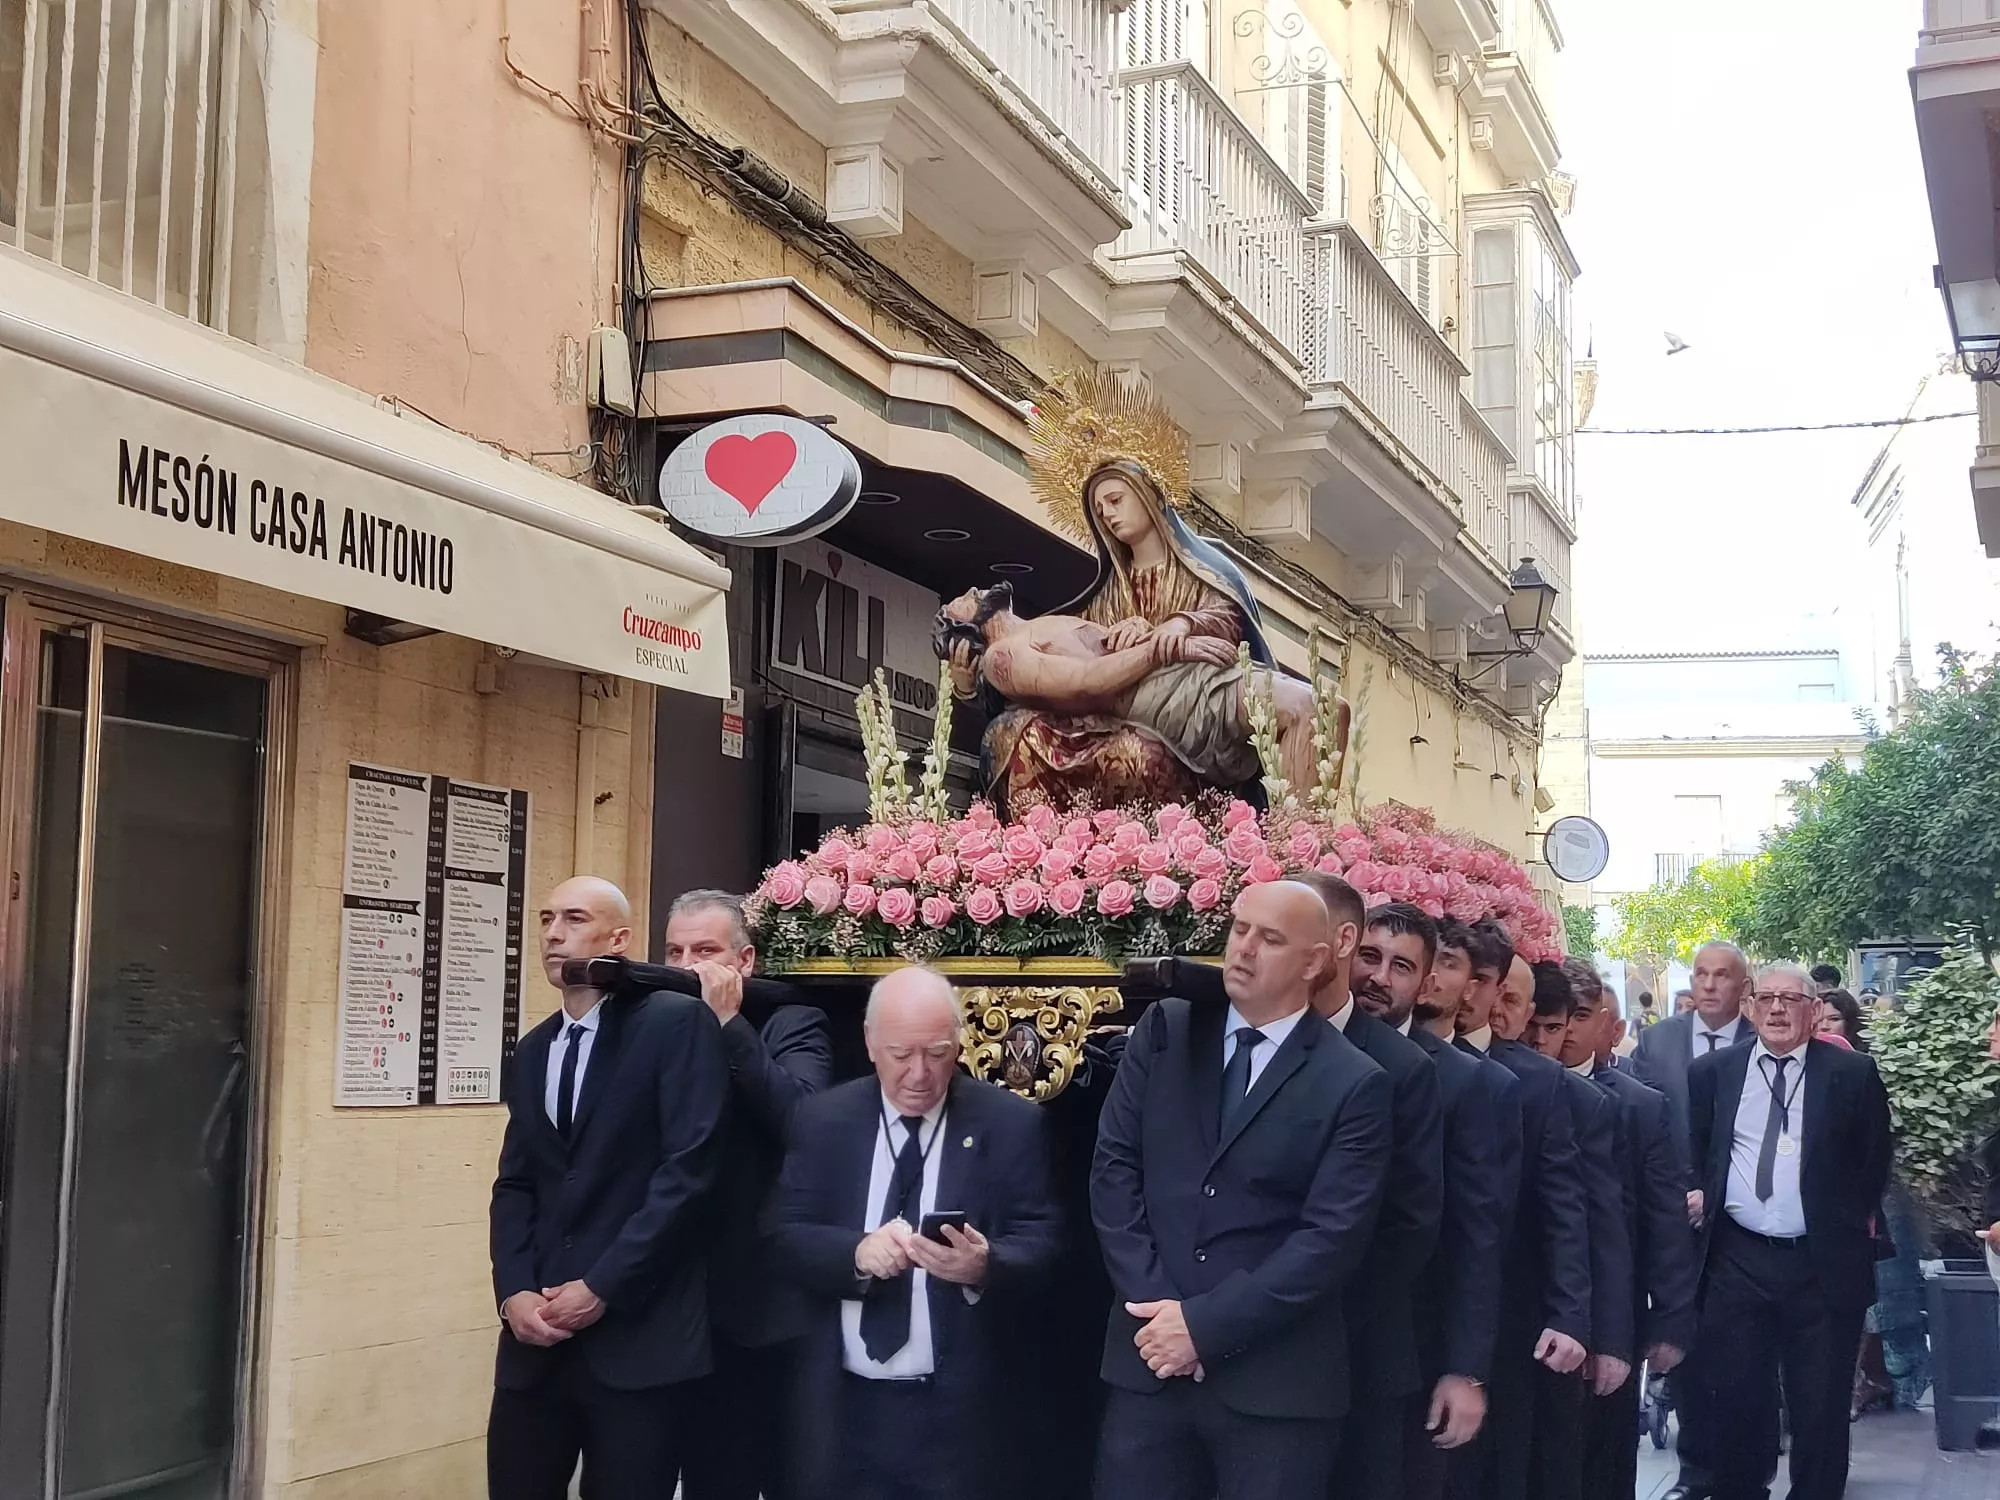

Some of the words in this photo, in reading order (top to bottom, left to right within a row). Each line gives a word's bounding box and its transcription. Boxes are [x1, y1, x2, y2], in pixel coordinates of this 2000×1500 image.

[118, 438, 237, 535] MESÓN
[249, 479, 328, 560] CASA
[338, 507, 454, 595] ANTONIO
[623, 604, 701, 652] Cruzcampo
[636, 647, 688, 675] ESPECIAL
[894, 671, 937, 711] SHOP
